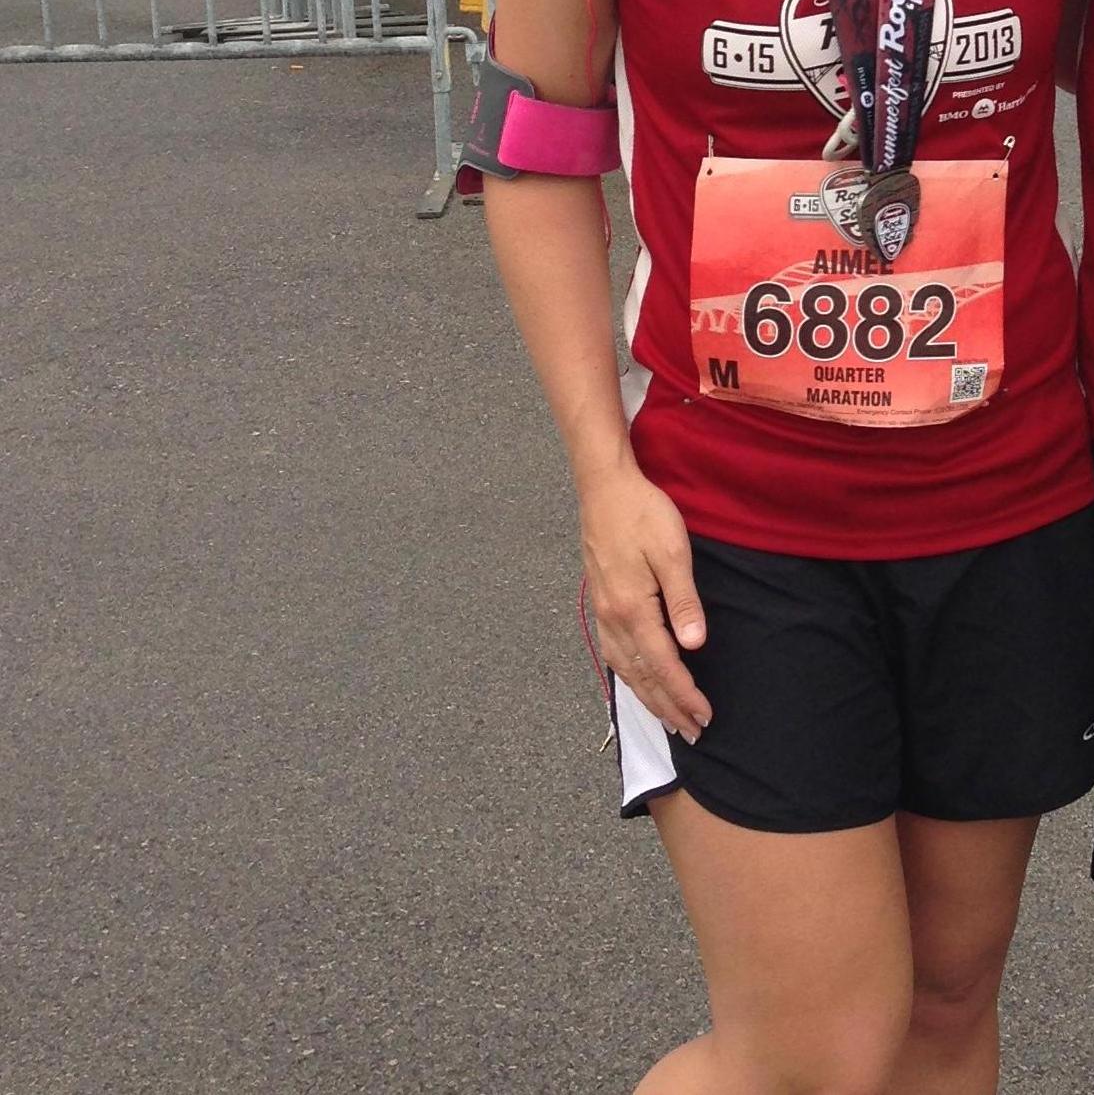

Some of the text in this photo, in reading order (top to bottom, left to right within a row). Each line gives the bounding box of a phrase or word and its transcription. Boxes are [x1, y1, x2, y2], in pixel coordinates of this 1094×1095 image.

[955, 25, 1016, 65] 2013
[938, 110, 970, 123] BMO
[834, 190, 860, 203] Ro
[839, 208, 858, 223] So
[742, 281, 958, 363] 6882
[708, 357, 740, 391] M
[814, 366, 886, 384] QUARTER
[806, 388, 893, 407] MARATHON
